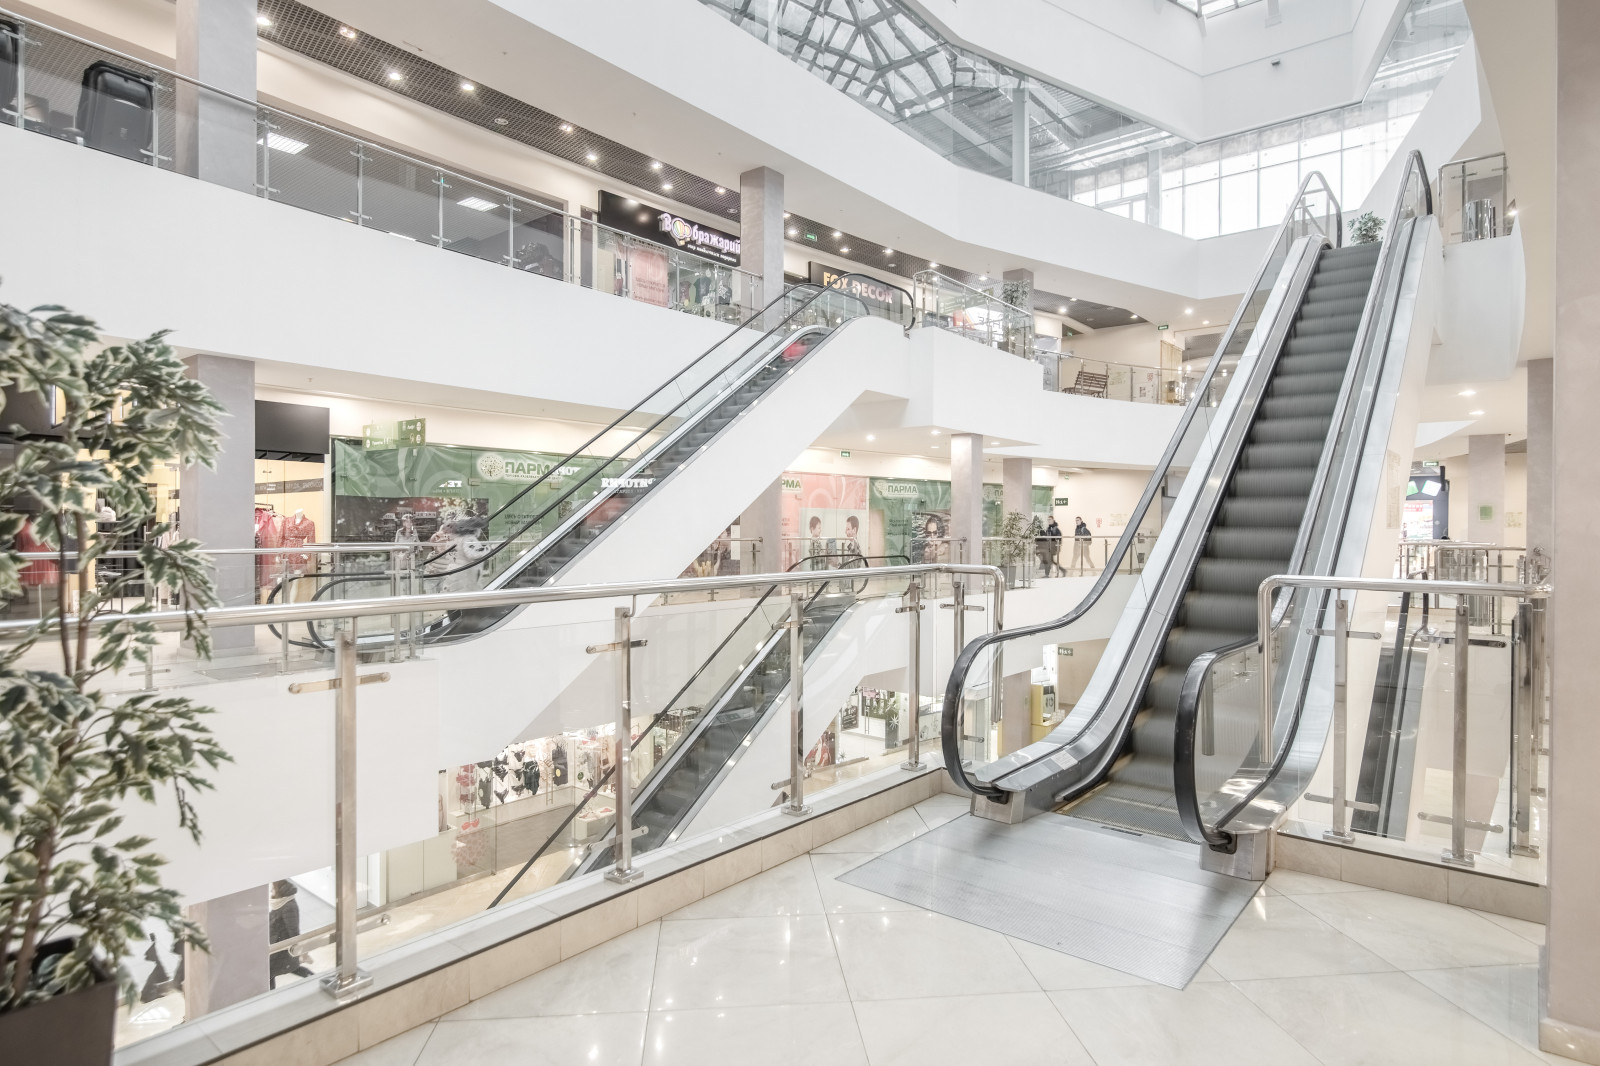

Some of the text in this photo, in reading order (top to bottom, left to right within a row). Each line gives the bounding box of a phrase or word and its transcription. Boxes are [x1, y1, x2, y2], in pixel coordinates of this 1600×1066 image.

[823, 271, 893, 304] FOX DECOR
[887, 484, 918, 494] ПАРМА
